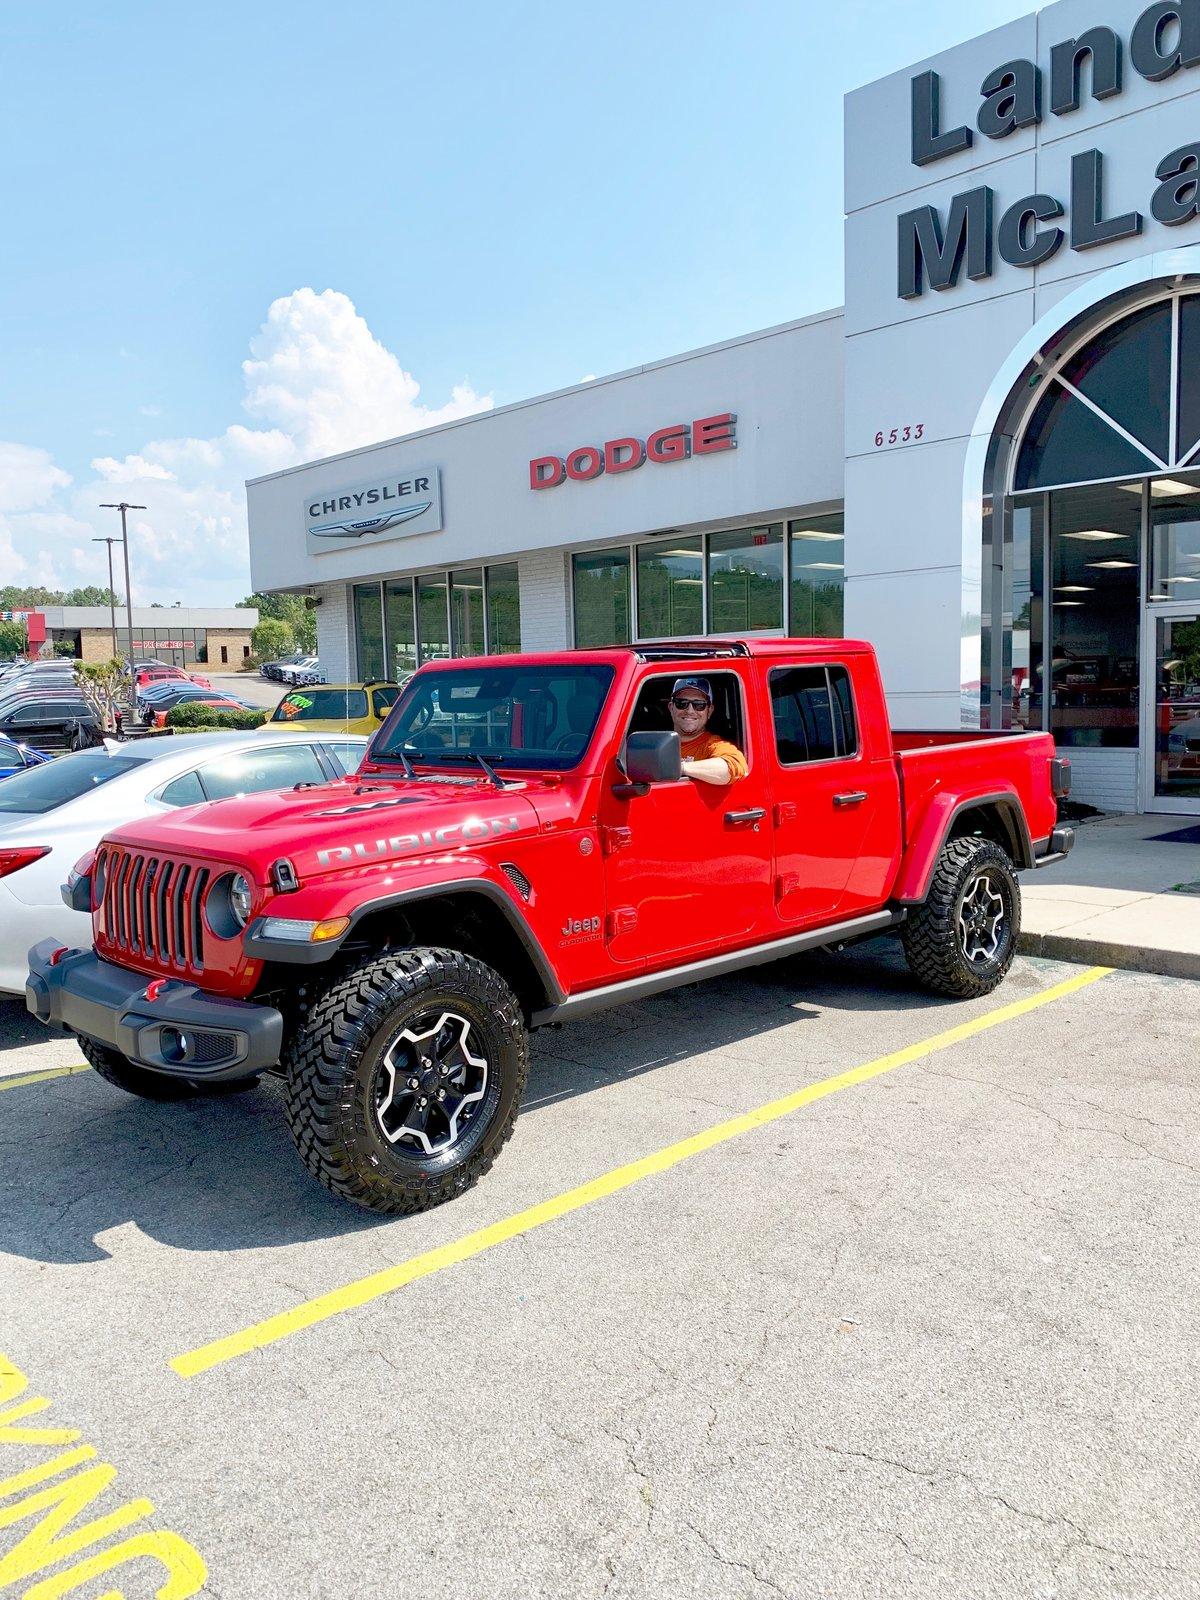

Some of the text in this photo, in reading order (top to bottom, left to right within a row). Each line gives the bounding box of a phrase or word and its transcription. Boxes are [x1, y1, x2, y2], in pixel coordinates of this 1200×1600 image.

[530, 412, 738, 490] DODGE
[875, 424, 924, 447] 6533
[309, 477, 430, 517] CHRYSLER
[316, 816, 520, 865] RUBICON
[561, 916, 601, 936] Jeep
